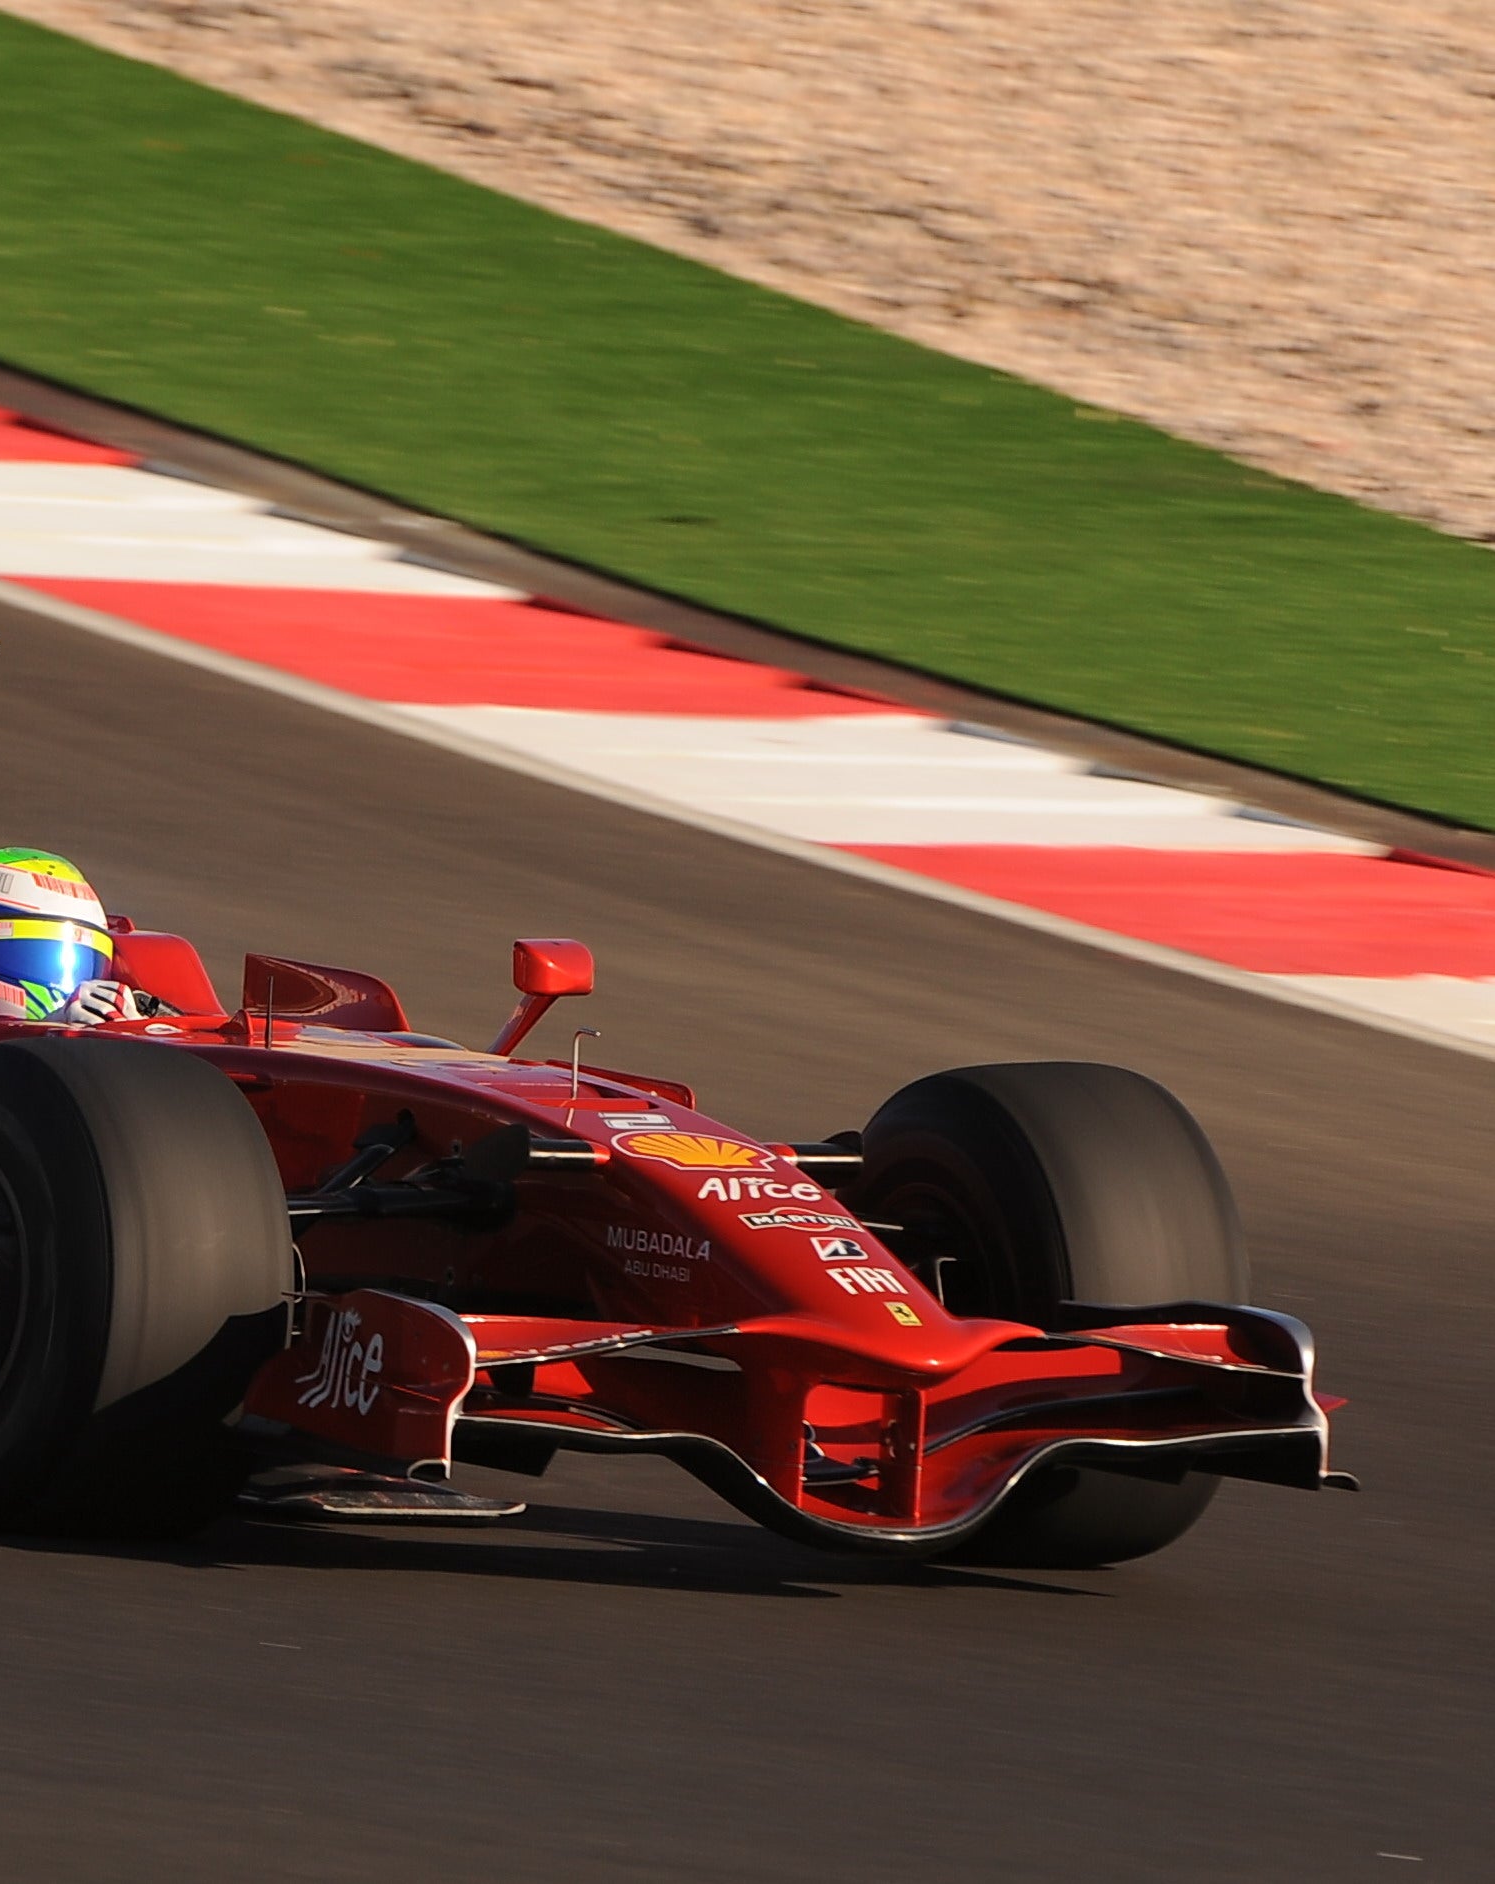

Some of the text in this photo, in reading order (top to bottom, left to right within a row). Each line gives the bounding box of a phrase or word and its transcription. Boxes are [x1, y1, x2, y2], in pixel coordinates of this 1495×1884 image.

[751, 1214, 852, 1228] MARTINI
[606, 1225, 711, 1261] MUBADALA
[624, 1259, 691, 1283] ABU DHABI
[826, 1266, 909, 1295] FIAT
[294, 1307, 384, 1416] Alice
